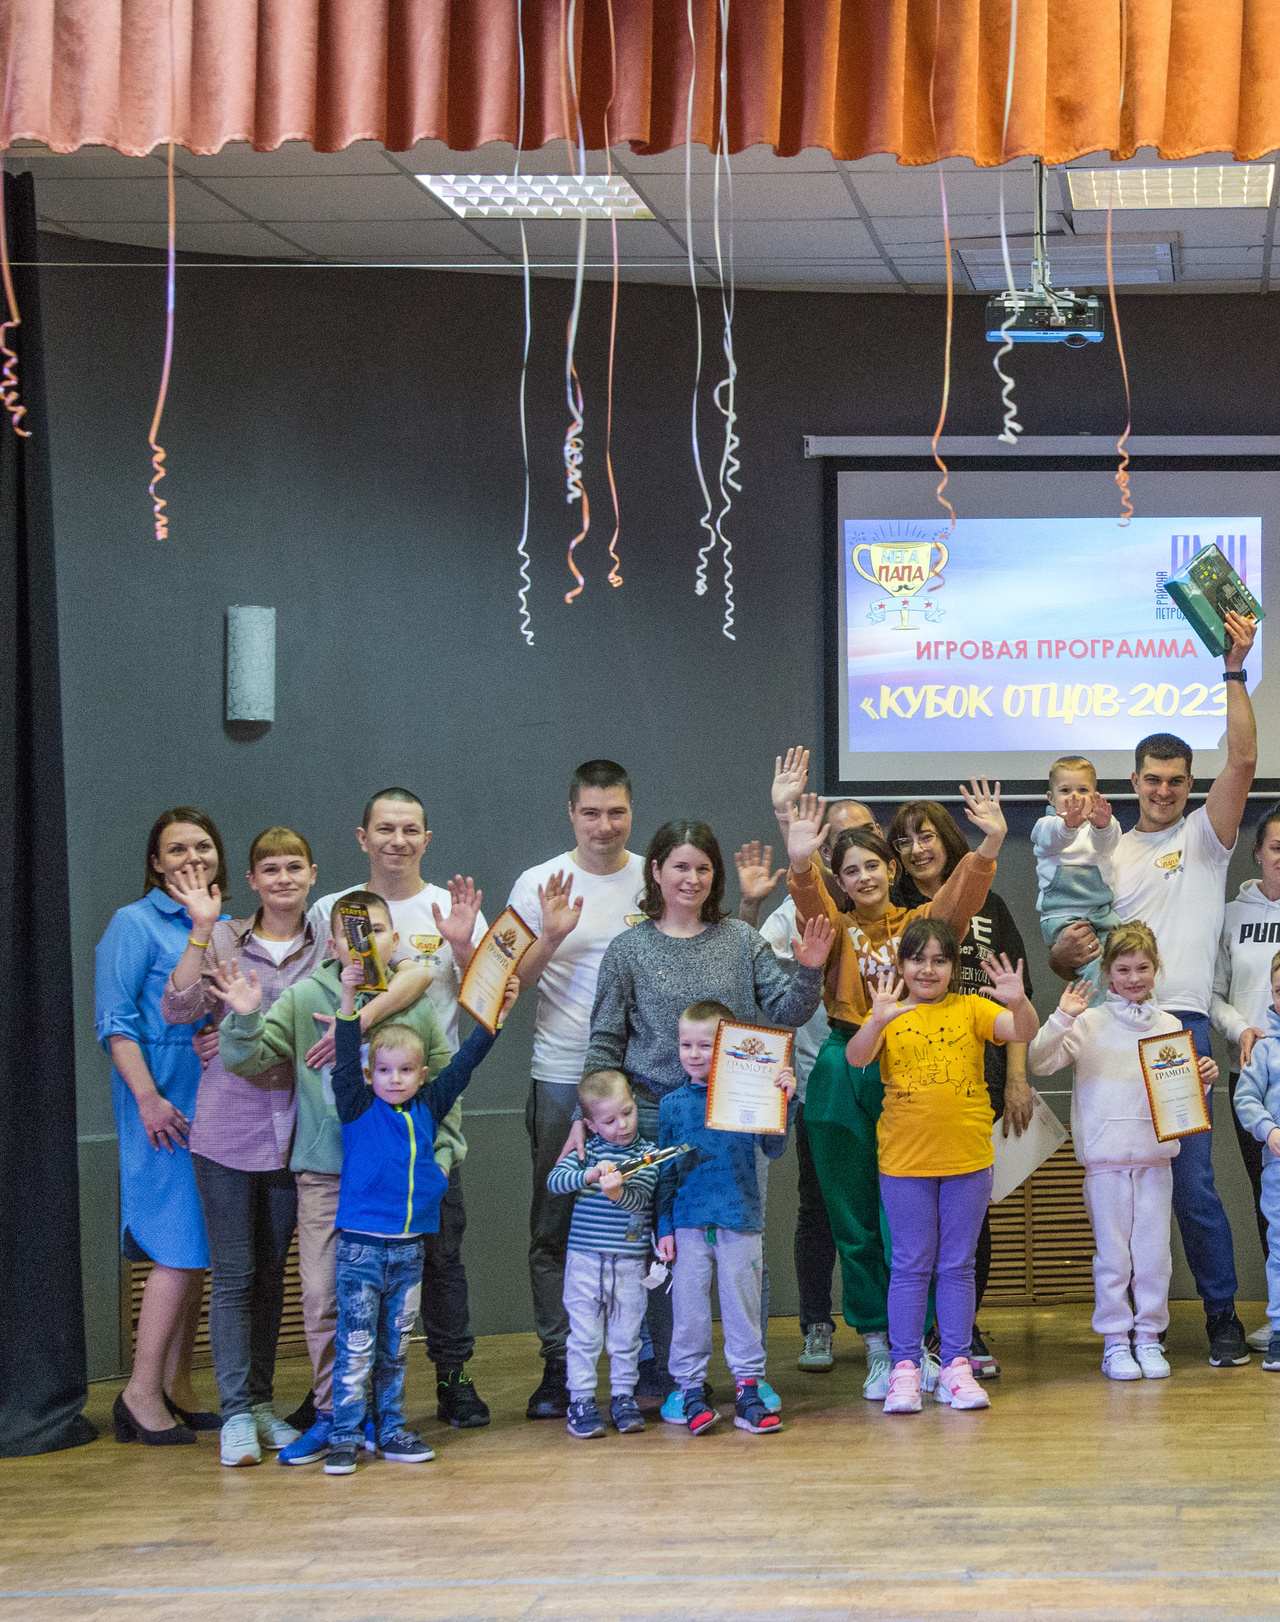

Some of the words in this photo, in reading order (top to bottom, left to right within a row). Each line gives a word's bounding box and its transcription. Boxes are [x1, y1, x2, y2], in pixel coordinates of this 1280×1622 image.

[881, 550, 919, 564] МЕГА
[879, 565, 924, 582] ПАПА
[1155, 571, 1168, 605] РАЙОНА
[916, 640, 1028, 660] ИГРОВАЯ
[1037, 639, 1199, 659] ПРОГРАММА
[860, 684, 994, 720] «КУБОК
[1002, 682, 1228, 724] ОТЦОВ-2023
[727, 1060, 773, 1074] ГРАМОТА
[1155, 1066, 1191, 1081] ГРАМОТА
